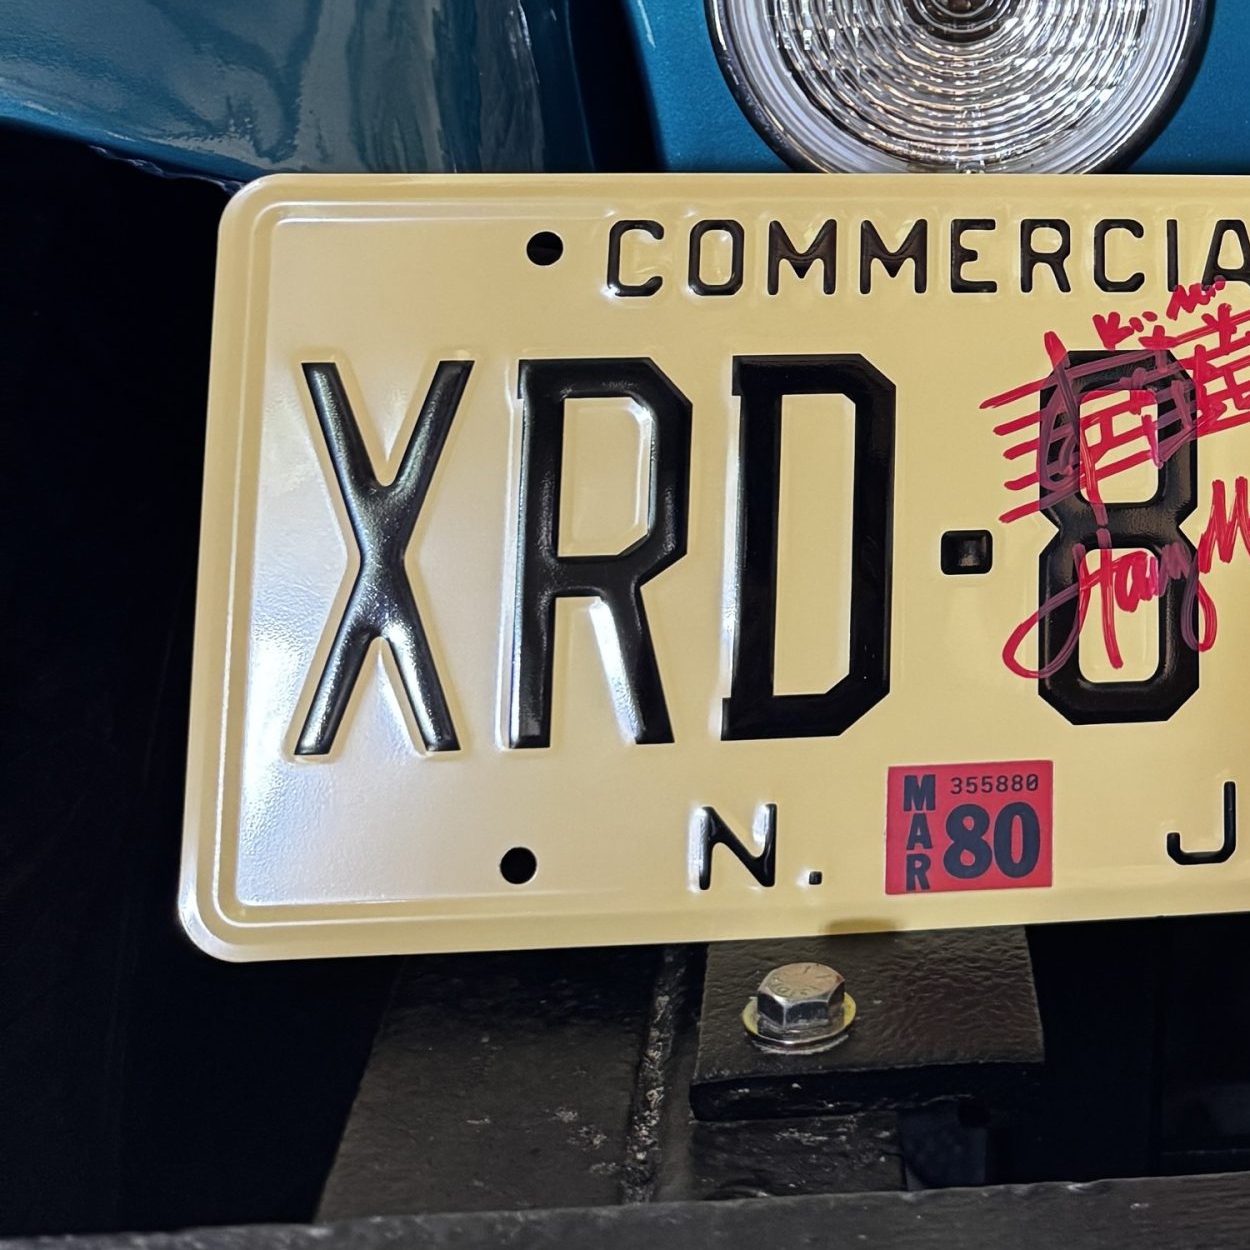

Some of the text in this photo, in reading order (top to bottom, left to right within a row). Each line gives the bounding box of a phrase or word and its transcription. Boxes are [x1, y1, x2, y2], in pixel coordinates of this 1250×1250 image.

[949, 773, 1040, 796] 355880
[698, 803, 823, 891] N.
[902, 773, 937, 892] MAR
[942, 801, 1042, 880] 80
